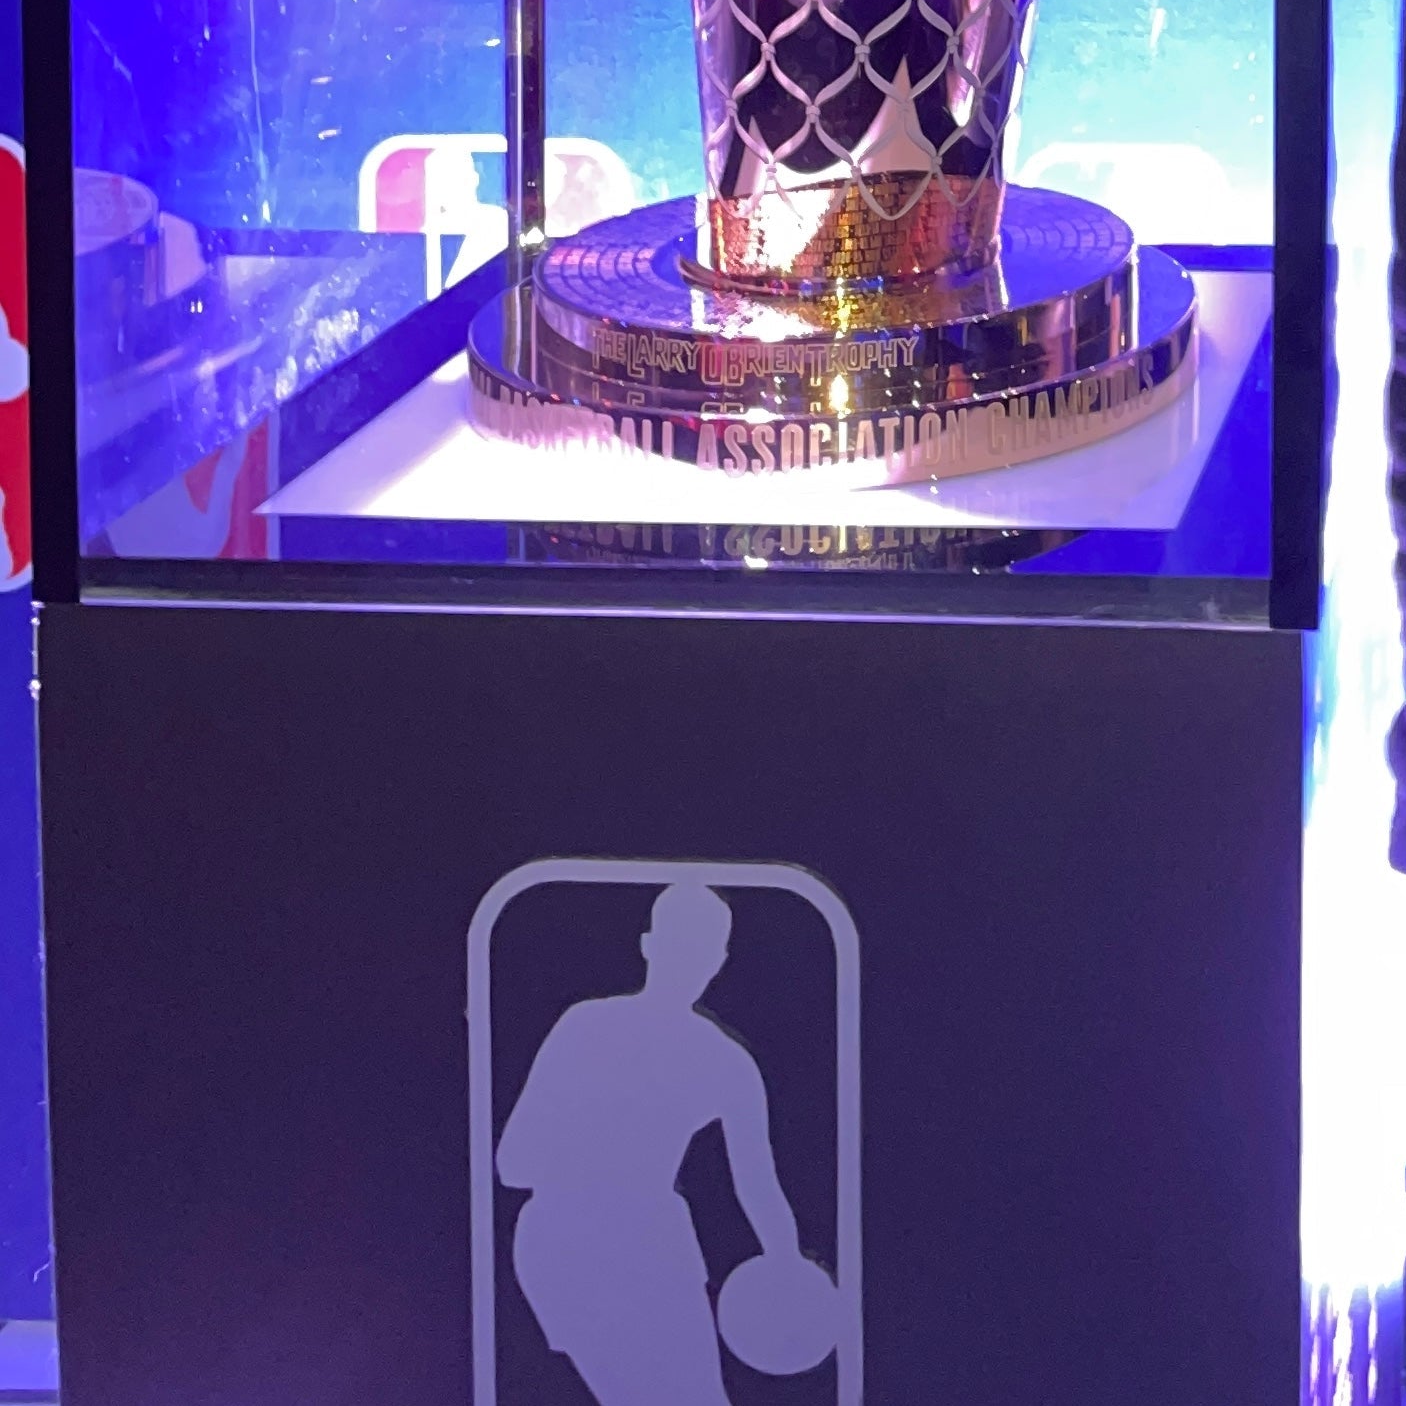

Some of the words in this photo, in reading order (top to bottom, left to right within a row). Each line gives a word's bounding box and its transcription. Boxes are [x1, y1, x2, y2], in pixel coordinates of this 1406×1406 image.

[627, 332, 700, 378] LARRY
[805, 336, 919, 386] TROPHY
[696, 407, 968, 478] ASSOCIATION
